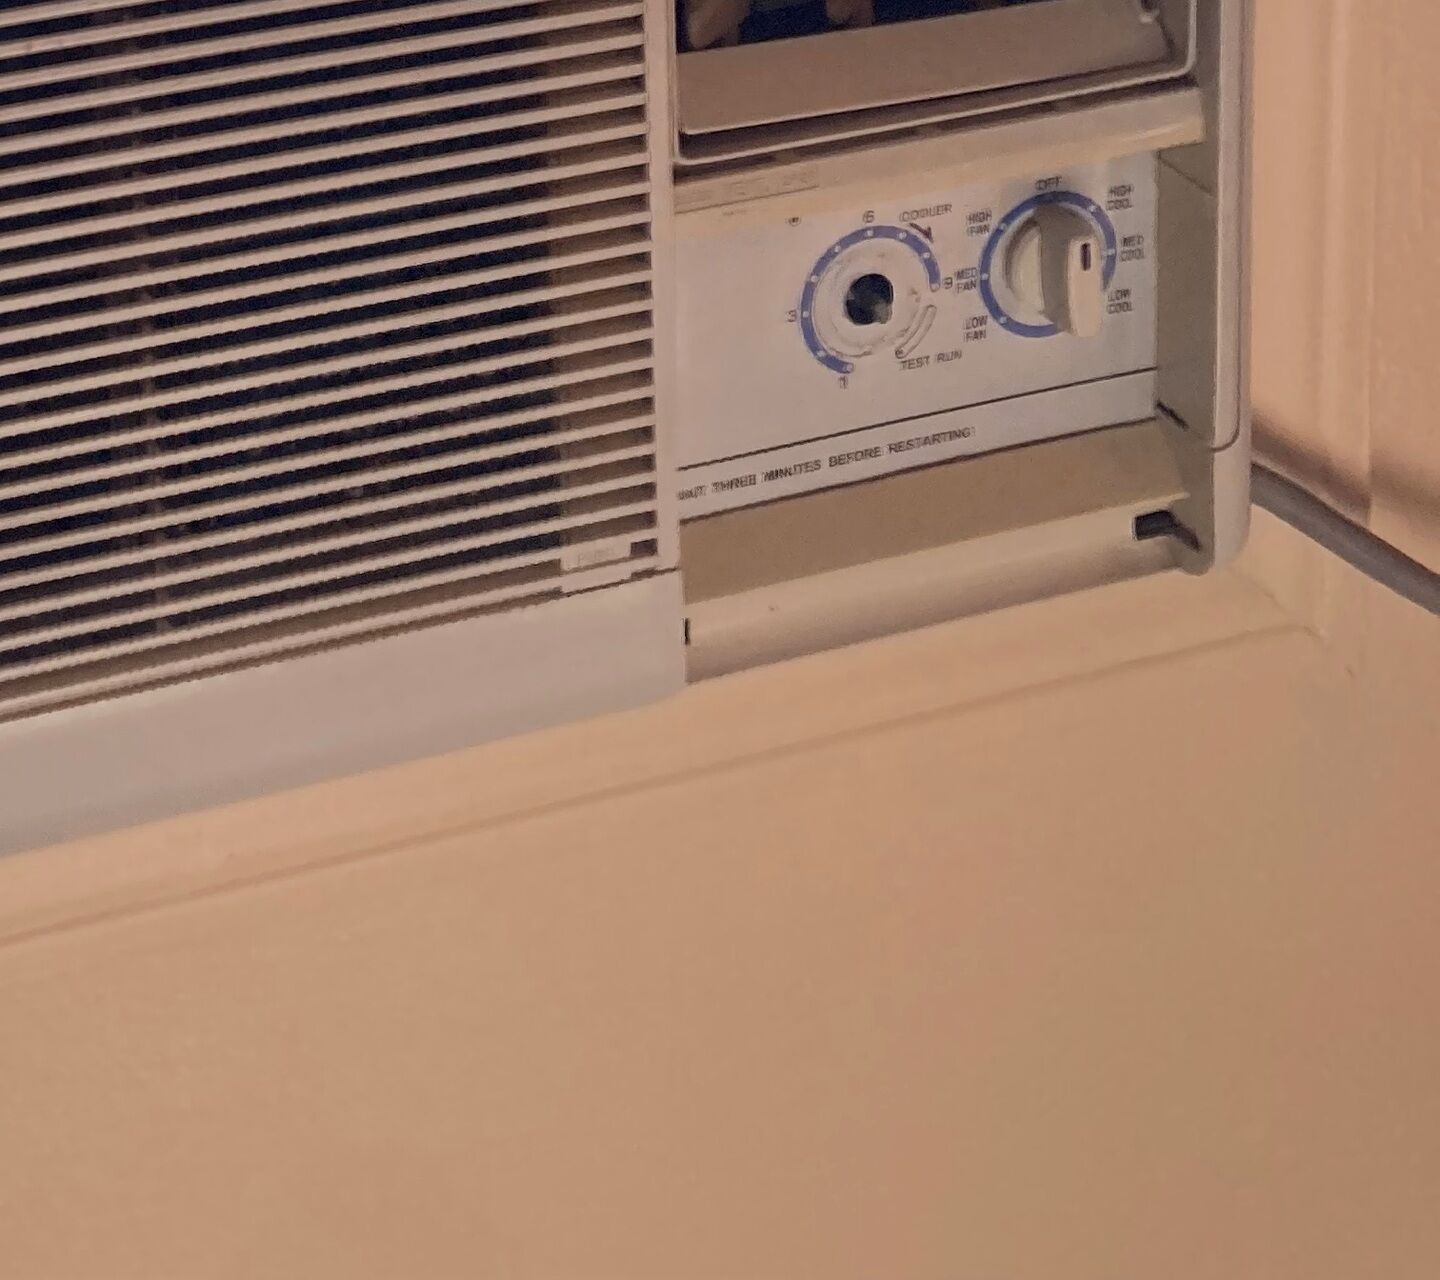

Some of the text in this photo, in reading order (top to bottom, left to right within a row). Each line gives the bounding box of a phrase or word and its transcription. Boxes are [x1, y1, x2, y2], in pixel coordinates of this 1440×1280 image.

[1034, 176, 1062, 191] OFF
[1108, 185, 1134, 198] HIGH
[1106, 198, 1133, 212] COOL
[862, 210, 875, 224] 6
[898, 203, 952, 224] COOLER
[966, 210, 992, 225] HIGH
[967, 223, 991, 237] FAN
[1121, 234, 1145, 248] MED
[1120, 248, 1146, 263] COOL
[954, 267, 978, 281] MED
[955, 280, 978, 295] FAN
[1107, 288, 1132, 303] LOW
[785, 309, 798, 323] 3
[1107, 302, 1133, 316] COOL
[964, 315, 988, 331] LOW
[963, 329, 988, 343] FAN
[899, 349, 963, 371] TEST RUN
[837, 376, 849, 390] 1
[710, 473, 758, 493] THREE
[761, 458, 822, 483] MINUTES
[828, 446, 883, 468] BEFORE
